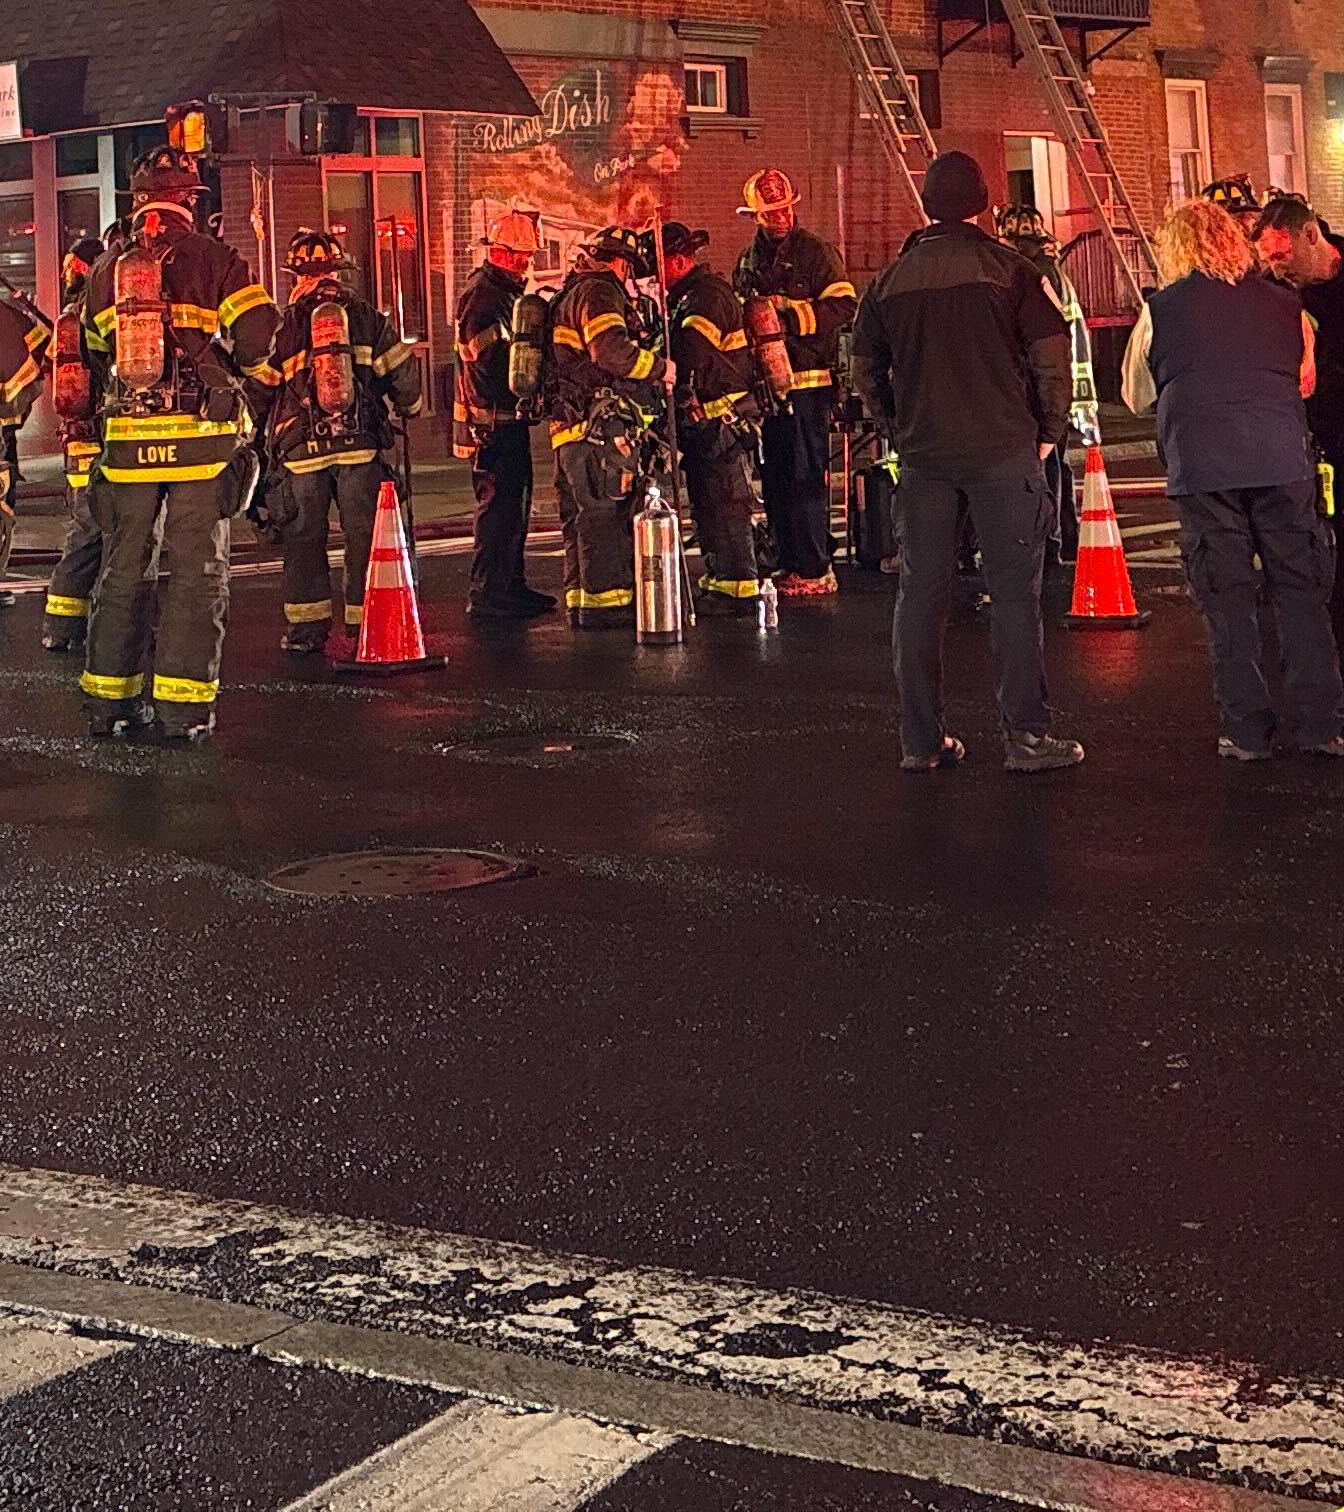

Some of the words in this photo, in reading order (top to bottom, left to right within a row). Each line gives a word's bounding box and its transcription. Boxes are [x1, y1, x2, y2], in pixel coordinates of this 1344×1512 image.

[473, 115, 543, 152] Rolling
[541, 69, 610, 136] Dish
[137, 445, 177, 464] LOVE
